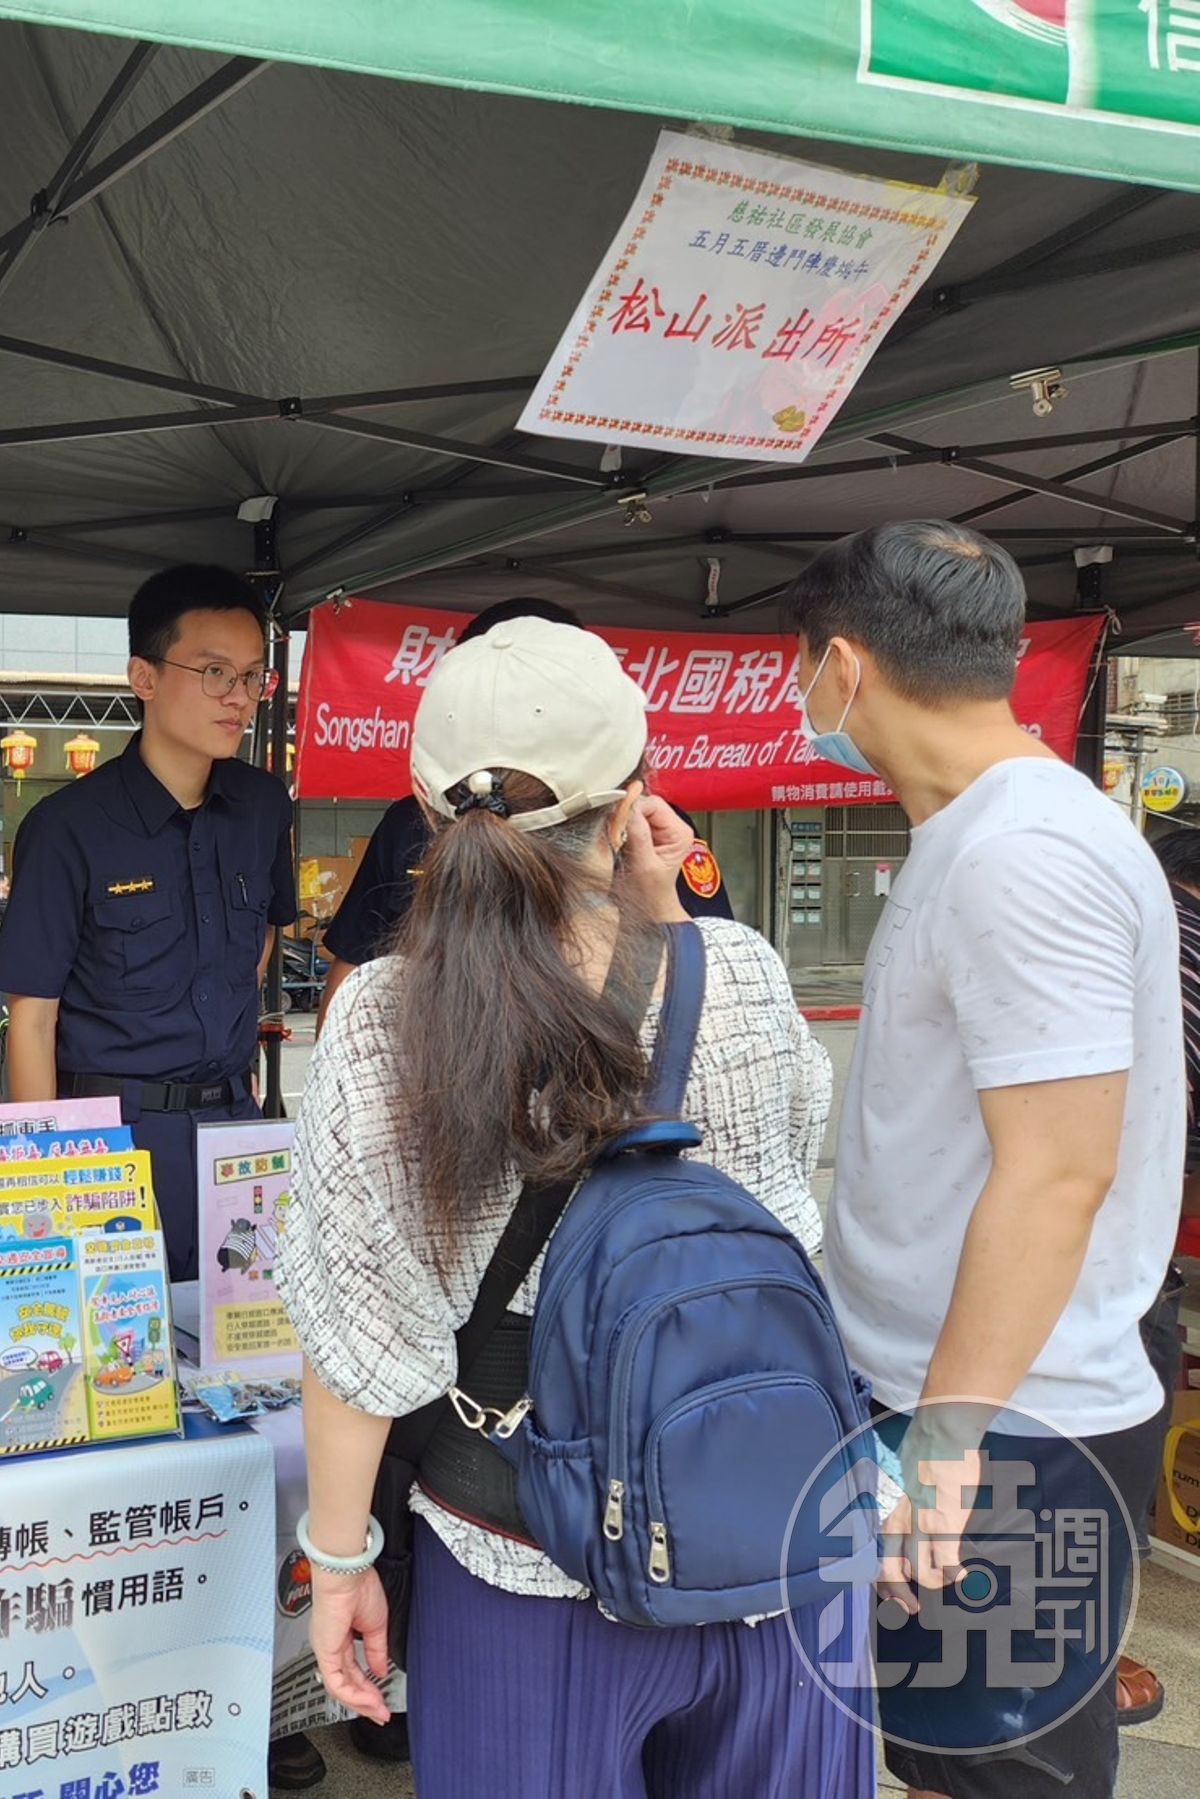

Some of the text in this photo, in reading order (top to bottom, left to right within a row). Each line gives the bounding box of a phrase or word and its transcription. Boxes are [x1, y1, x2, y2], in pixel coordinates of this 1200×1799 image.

[726, 200, 874, 250] 慈祐社區發展協會
[606, 277, 860, 369] 松山派出所
[313, 702, 411, 752] Songshan
[683, 734, 755, 770] Bureau
[757, 730, 789, 766] of
[771, 780, 893, 802] 購物消費請使用載
[81, 1566, 209, 1617] 慣用語。
